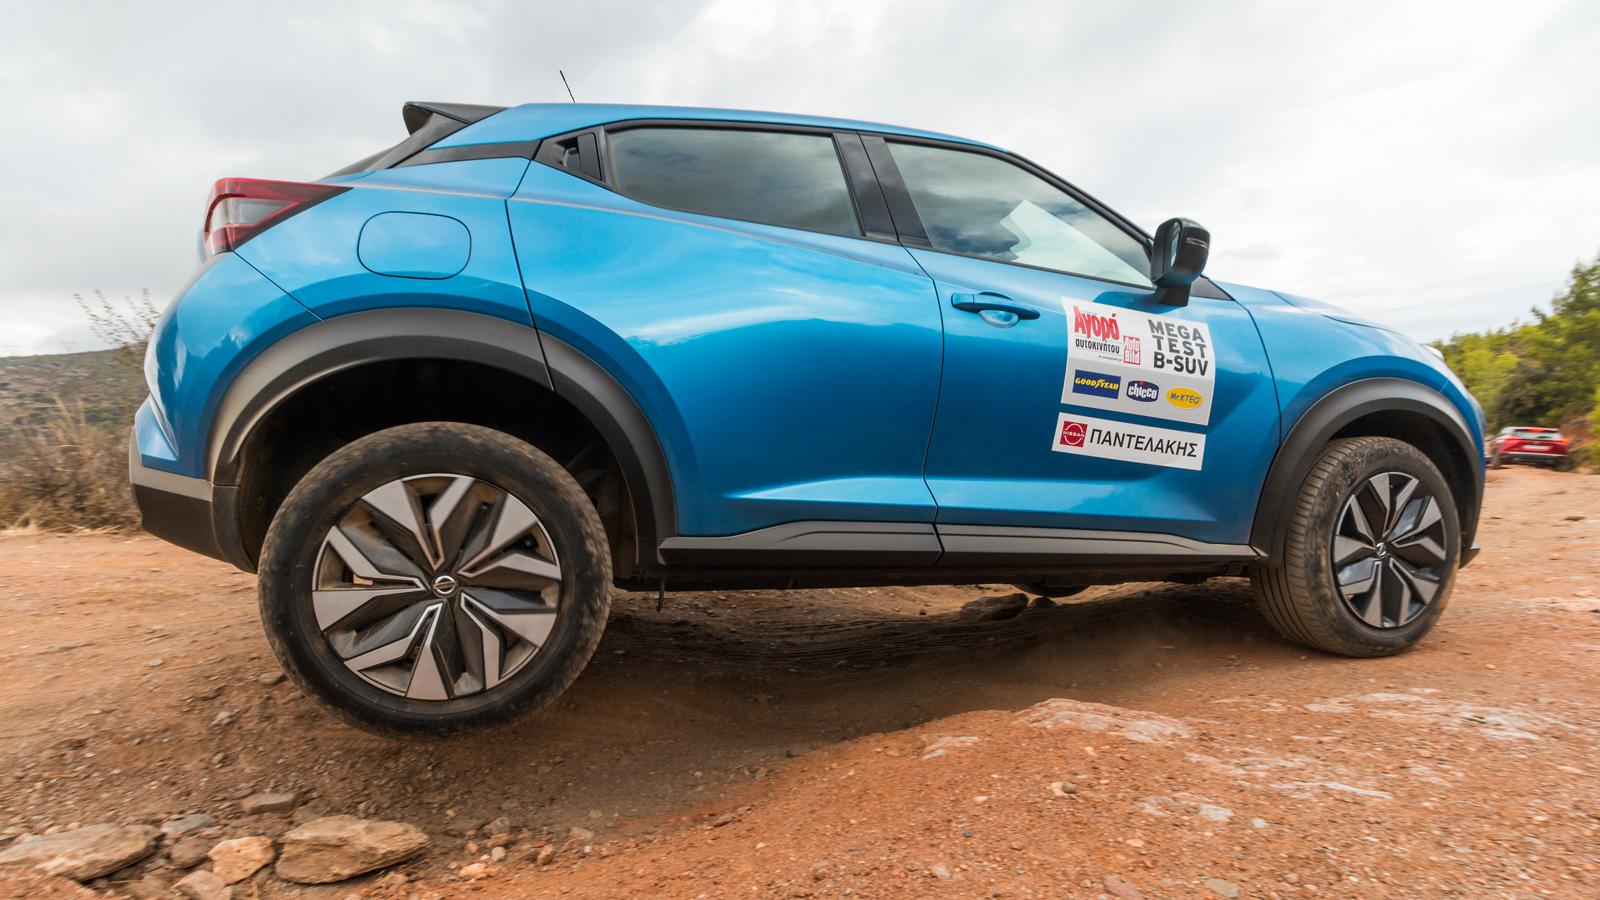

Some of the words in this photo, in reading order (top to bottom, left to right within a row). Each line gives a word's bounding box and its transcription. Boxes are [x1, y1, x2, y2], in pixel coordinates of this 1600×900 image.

[1073, 305, 1120, 342] Αγορά
[1147, 319, 1205, 343] MEGA
[1075, 338, 1120, 354] αυτοκινήτου
[1123, 336, 1140, 352] Auto
[1152, 335, 1207, 358] TEST
[1125, 350, 1140, 364] Bild
[1153, 351, 1209, 376] B-SUV
[1075, 377, 1120, 391] GOODYEAR
[1128, 381, 1158, 399] chicco
[1062, 430, 1085, 438] NISSAN
[1089, 428, 1198, 458] ΠΑΝΤΕΛΑΚΗΣ
